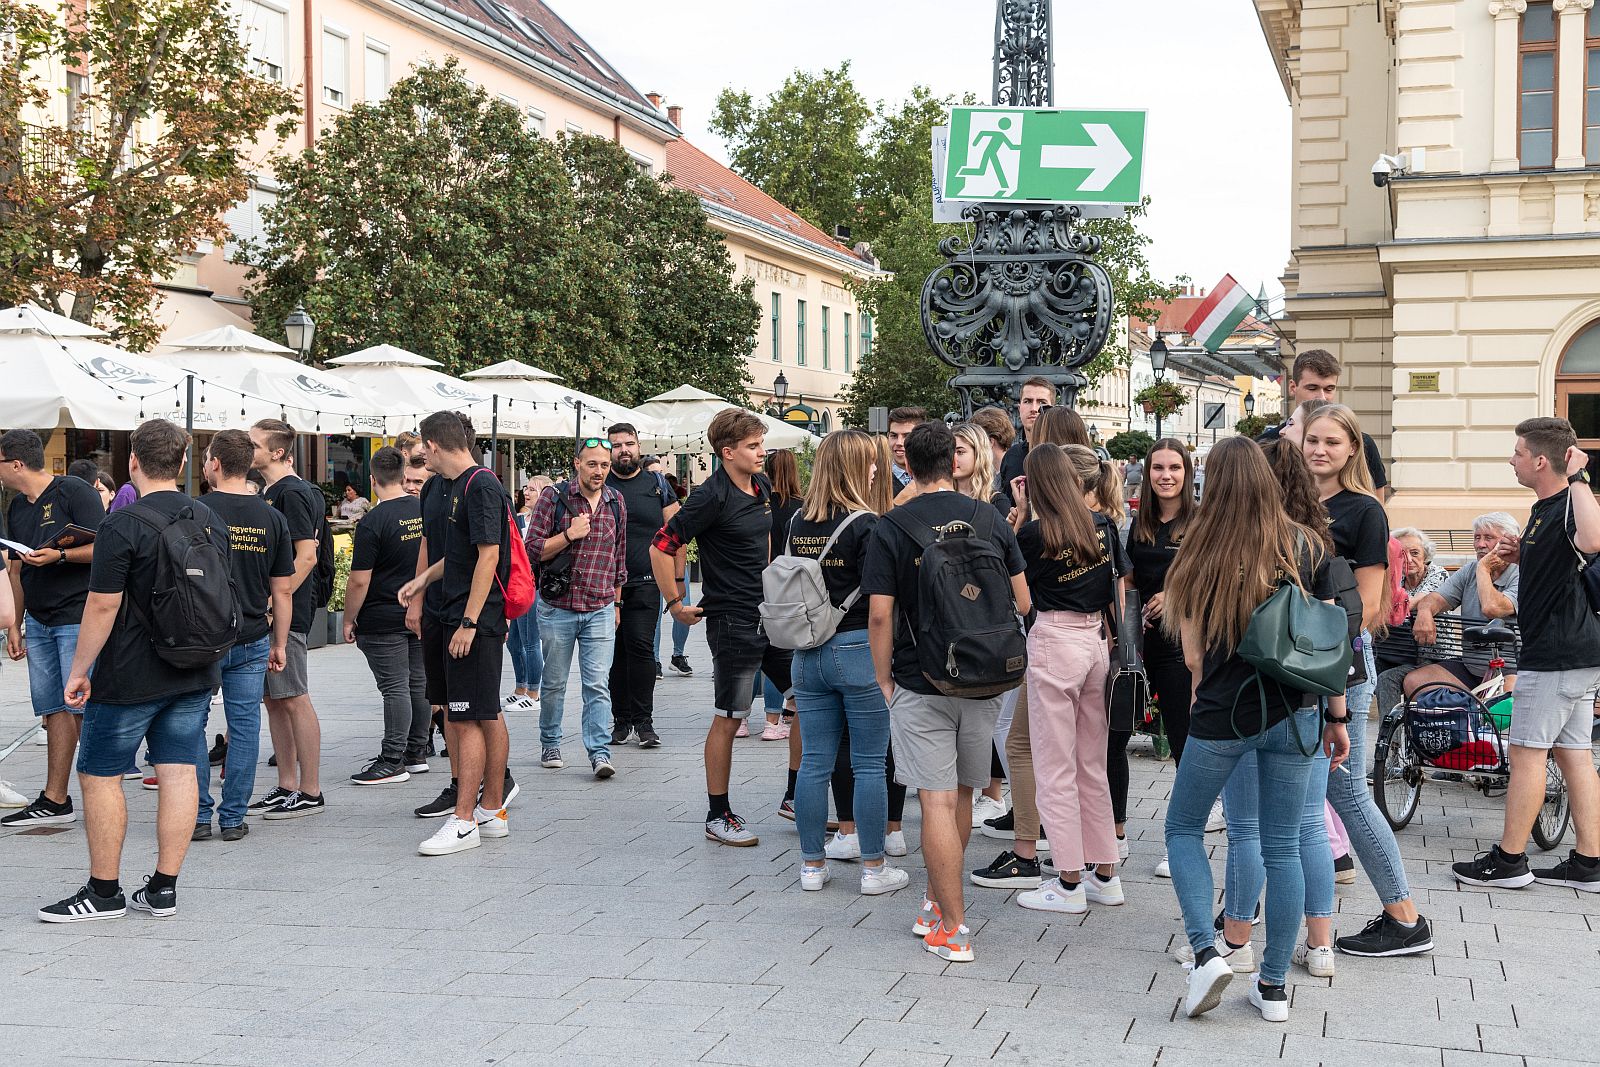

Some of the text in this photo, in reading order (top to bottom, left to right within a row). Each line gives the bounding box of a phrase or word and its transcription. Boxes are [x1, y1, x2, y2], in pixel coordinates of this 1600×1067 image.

[153, 408, 213, 423] CUKRÁZDA
[227, 525, 266, 535] zegyetemi
[231, 533, 258, 543] lyatúra
[231, 543, 267, 553] esfehérvár
[797, 544, 832, 555] GÓLYAT
